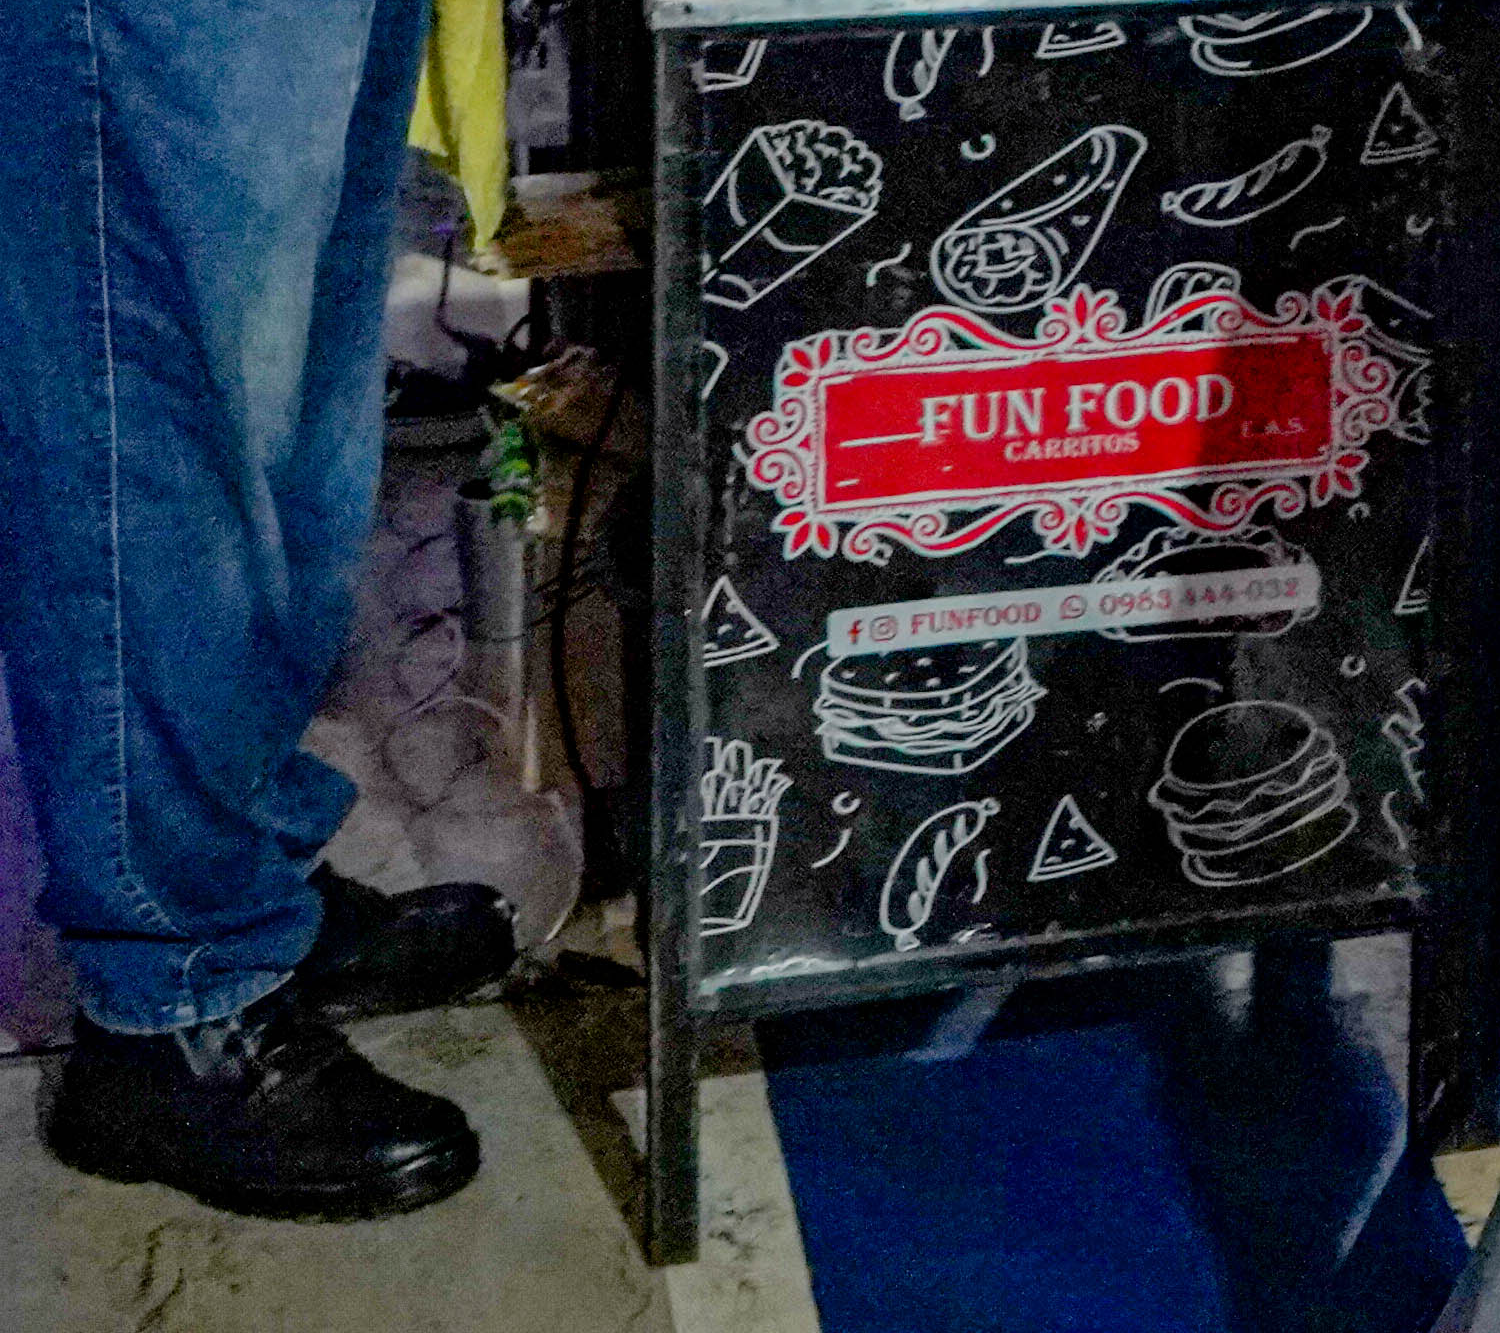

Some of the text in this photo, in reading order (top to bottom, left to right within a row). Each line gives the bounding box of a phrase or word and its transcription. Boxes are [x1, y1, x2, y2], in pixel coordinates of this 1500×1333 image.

[918, 373, 1235, 446] FUN FOOD
[1003, 432, 1141, 463] CARRITOS
[910, 602, 1043, 636] FUNFOOD
